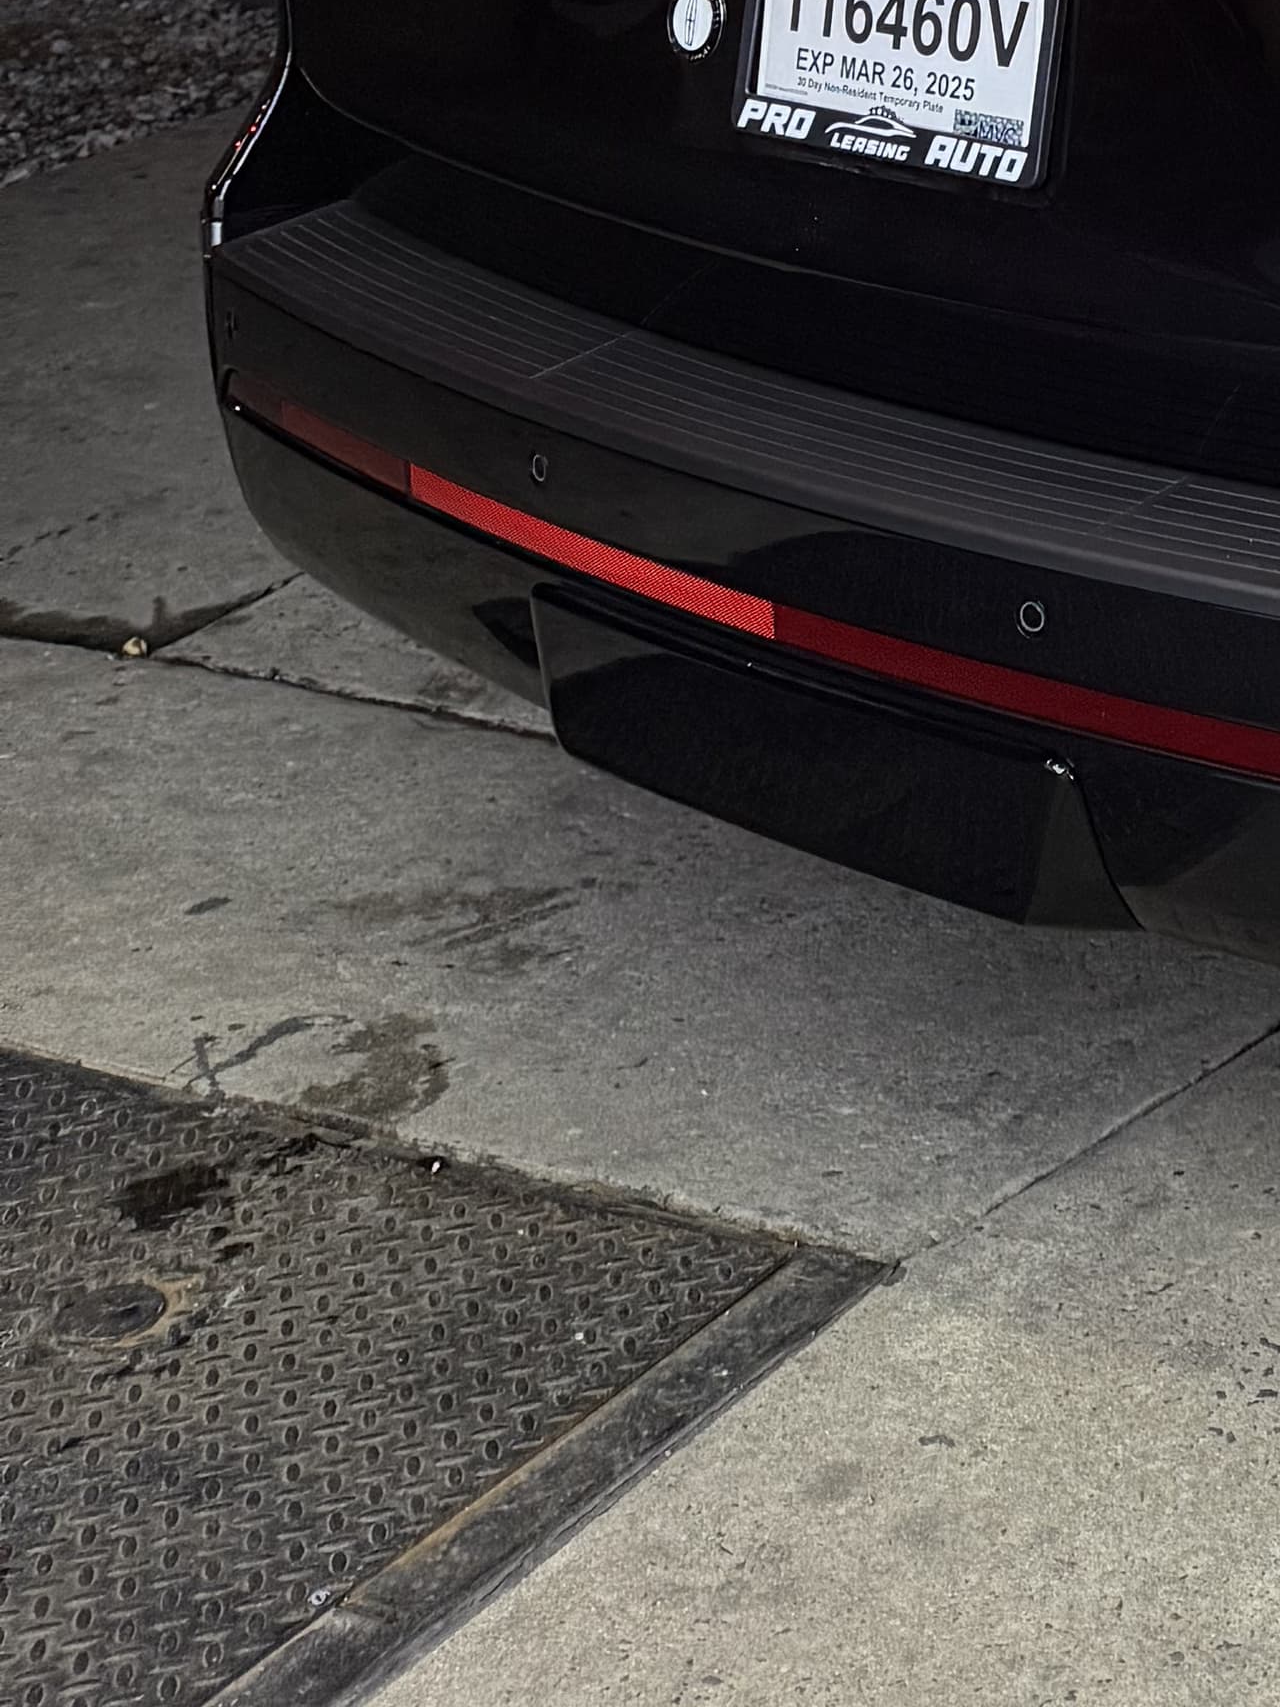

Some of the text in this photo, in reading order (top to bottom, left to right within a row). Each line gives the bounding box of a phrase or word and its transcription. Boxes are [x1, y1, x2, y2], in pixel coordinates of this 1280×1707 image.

[795, 47, 976, 102] EXP MAR 26, 2025
[808, 78, 823, 93] Day
[824, 81, 878, 103] Non-Resident
[879, 91, 921, 113] Temporary
[923, 100, 944, 114] Plate
[736, 98, 817, 139] PRO
[829, 132, 911, 162] LEASING
[924, 135, 1029, 183] AUTO
